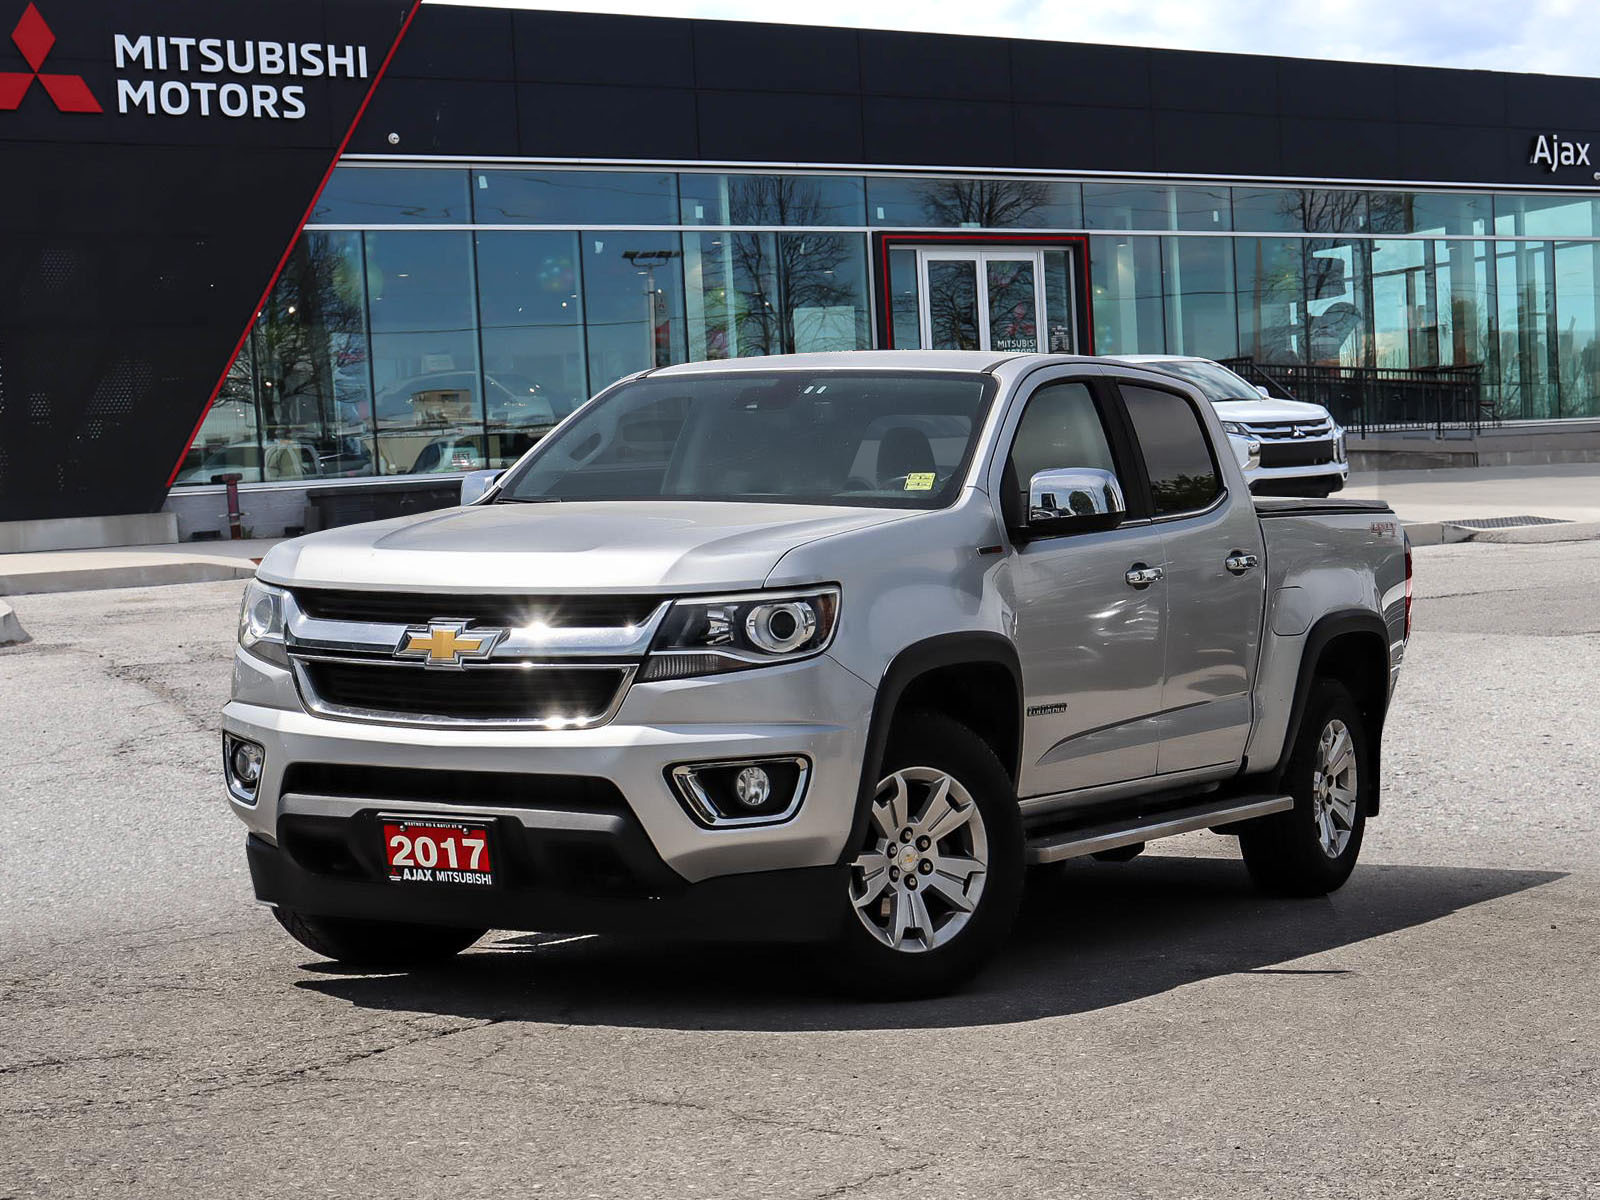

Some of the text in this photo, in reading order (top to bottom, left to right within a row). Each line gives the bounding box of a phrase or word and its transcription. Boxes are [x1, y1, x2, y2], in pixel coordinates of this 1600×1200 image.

[114, 34, 368, 78] MITSUBISHI
[117, 79, 306, 119] MOTORS
[1533, 134, 1591, 172] Ajax
[390, 835, 484, 869] 2017
[403, 868, 492, 885] AJAX MITSUBISHI
